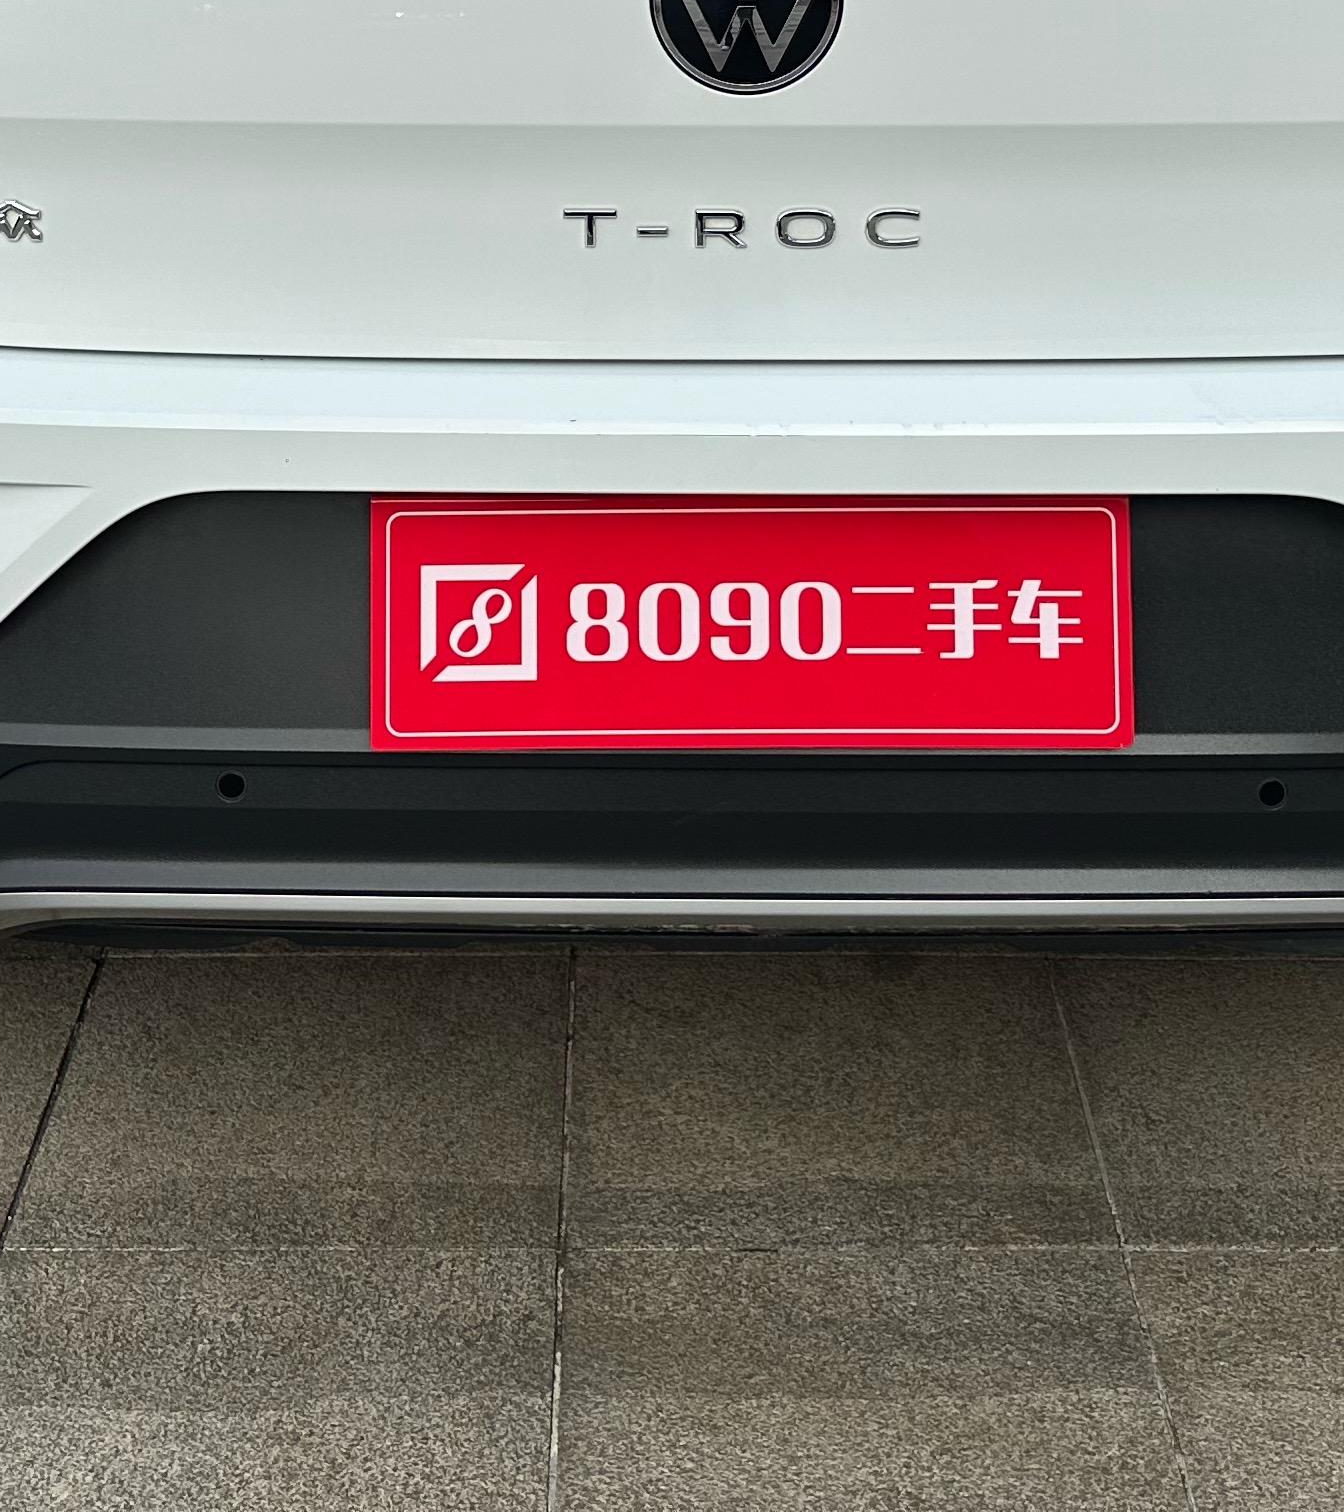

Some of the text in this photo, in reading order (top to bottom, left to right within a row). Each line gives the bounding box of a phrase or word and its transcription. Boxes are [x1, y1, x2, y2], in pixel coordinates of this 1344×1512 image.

[563, 207, 921, 249] T-ROC
[566, 578, 1084, 662] 8090二手车
